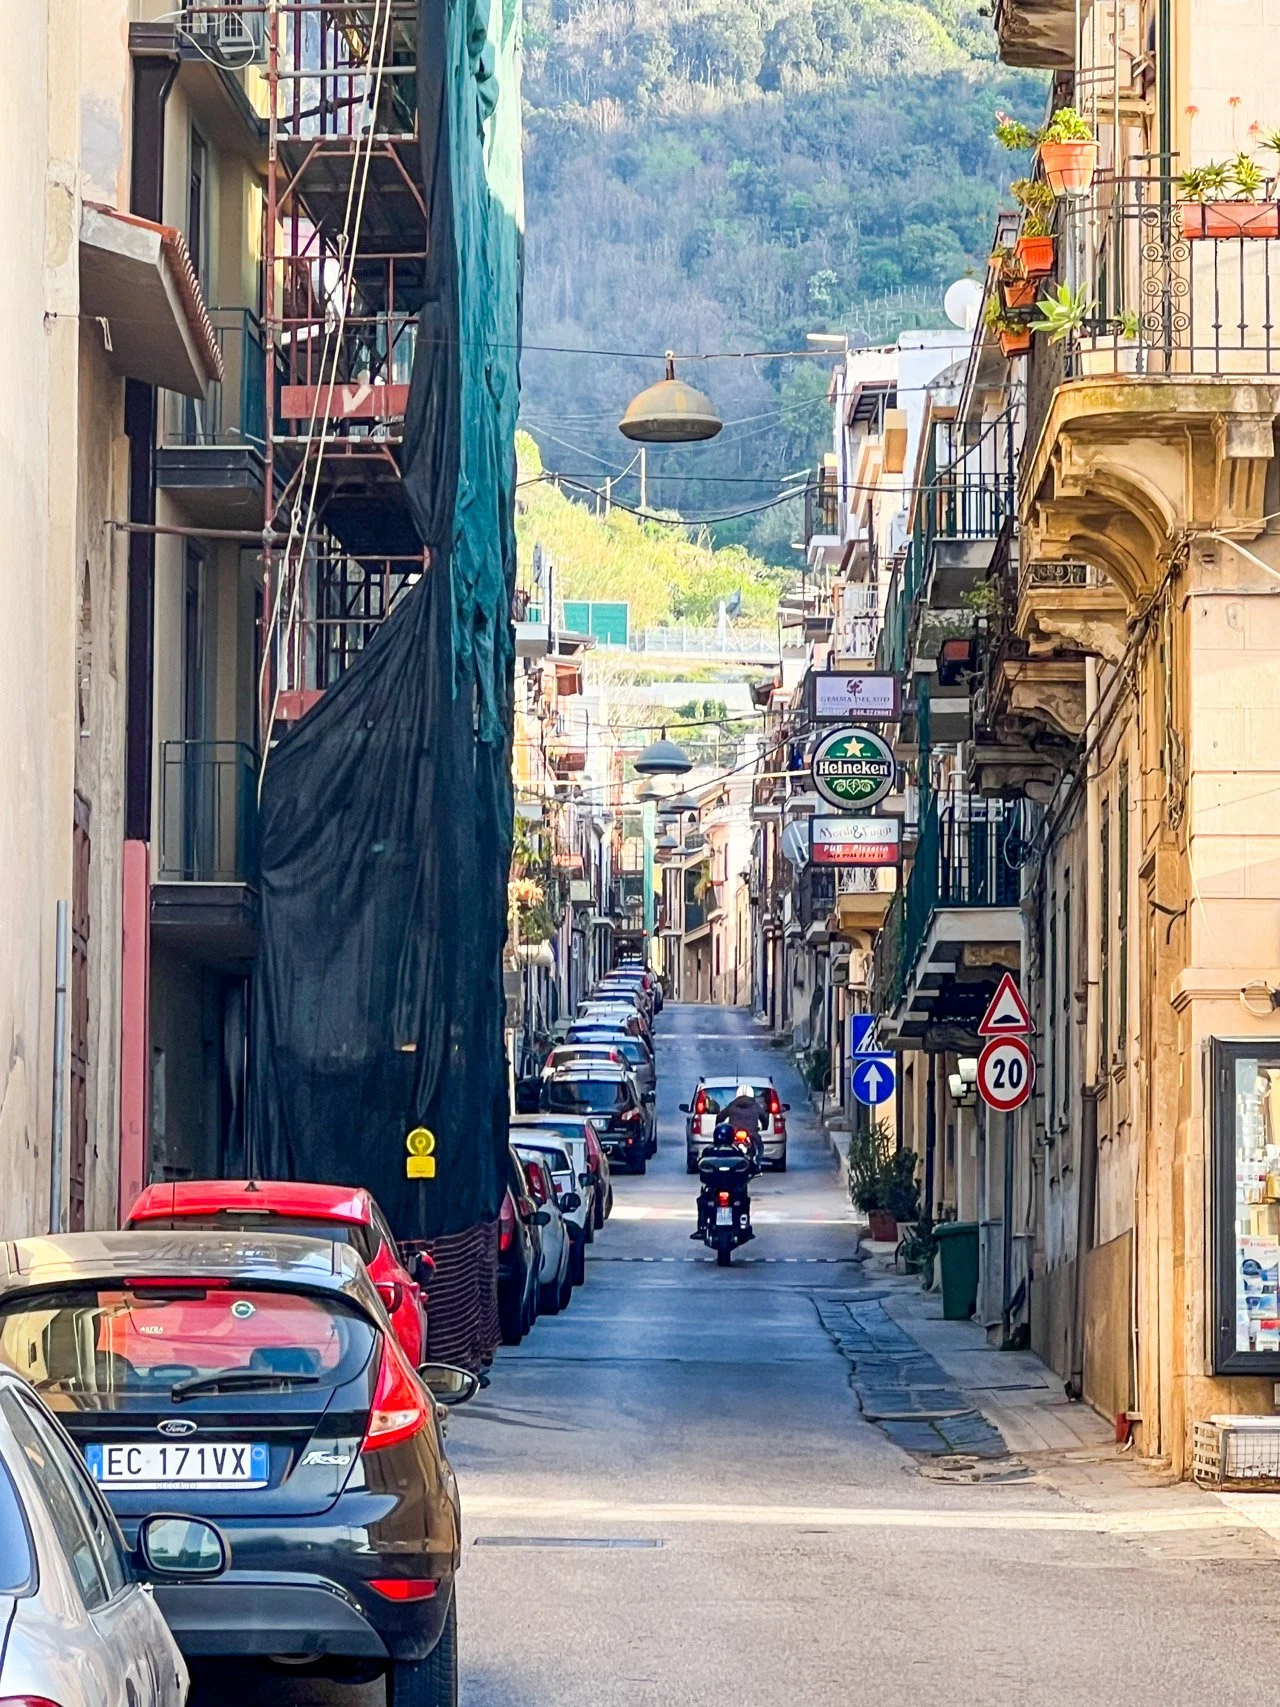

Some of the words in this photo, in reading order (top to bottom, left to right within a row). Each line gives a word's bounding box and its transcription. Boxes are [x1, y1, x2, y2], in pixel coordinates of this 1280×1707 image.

[818, 761, 889, 776] Heineken
[992, 1058, 1023, 1089] 20
[165, 1422, 187, 1433] Ford
[108, 1447, 142, 1476] EC
[158, 1446, 246, 1476] 171VX
